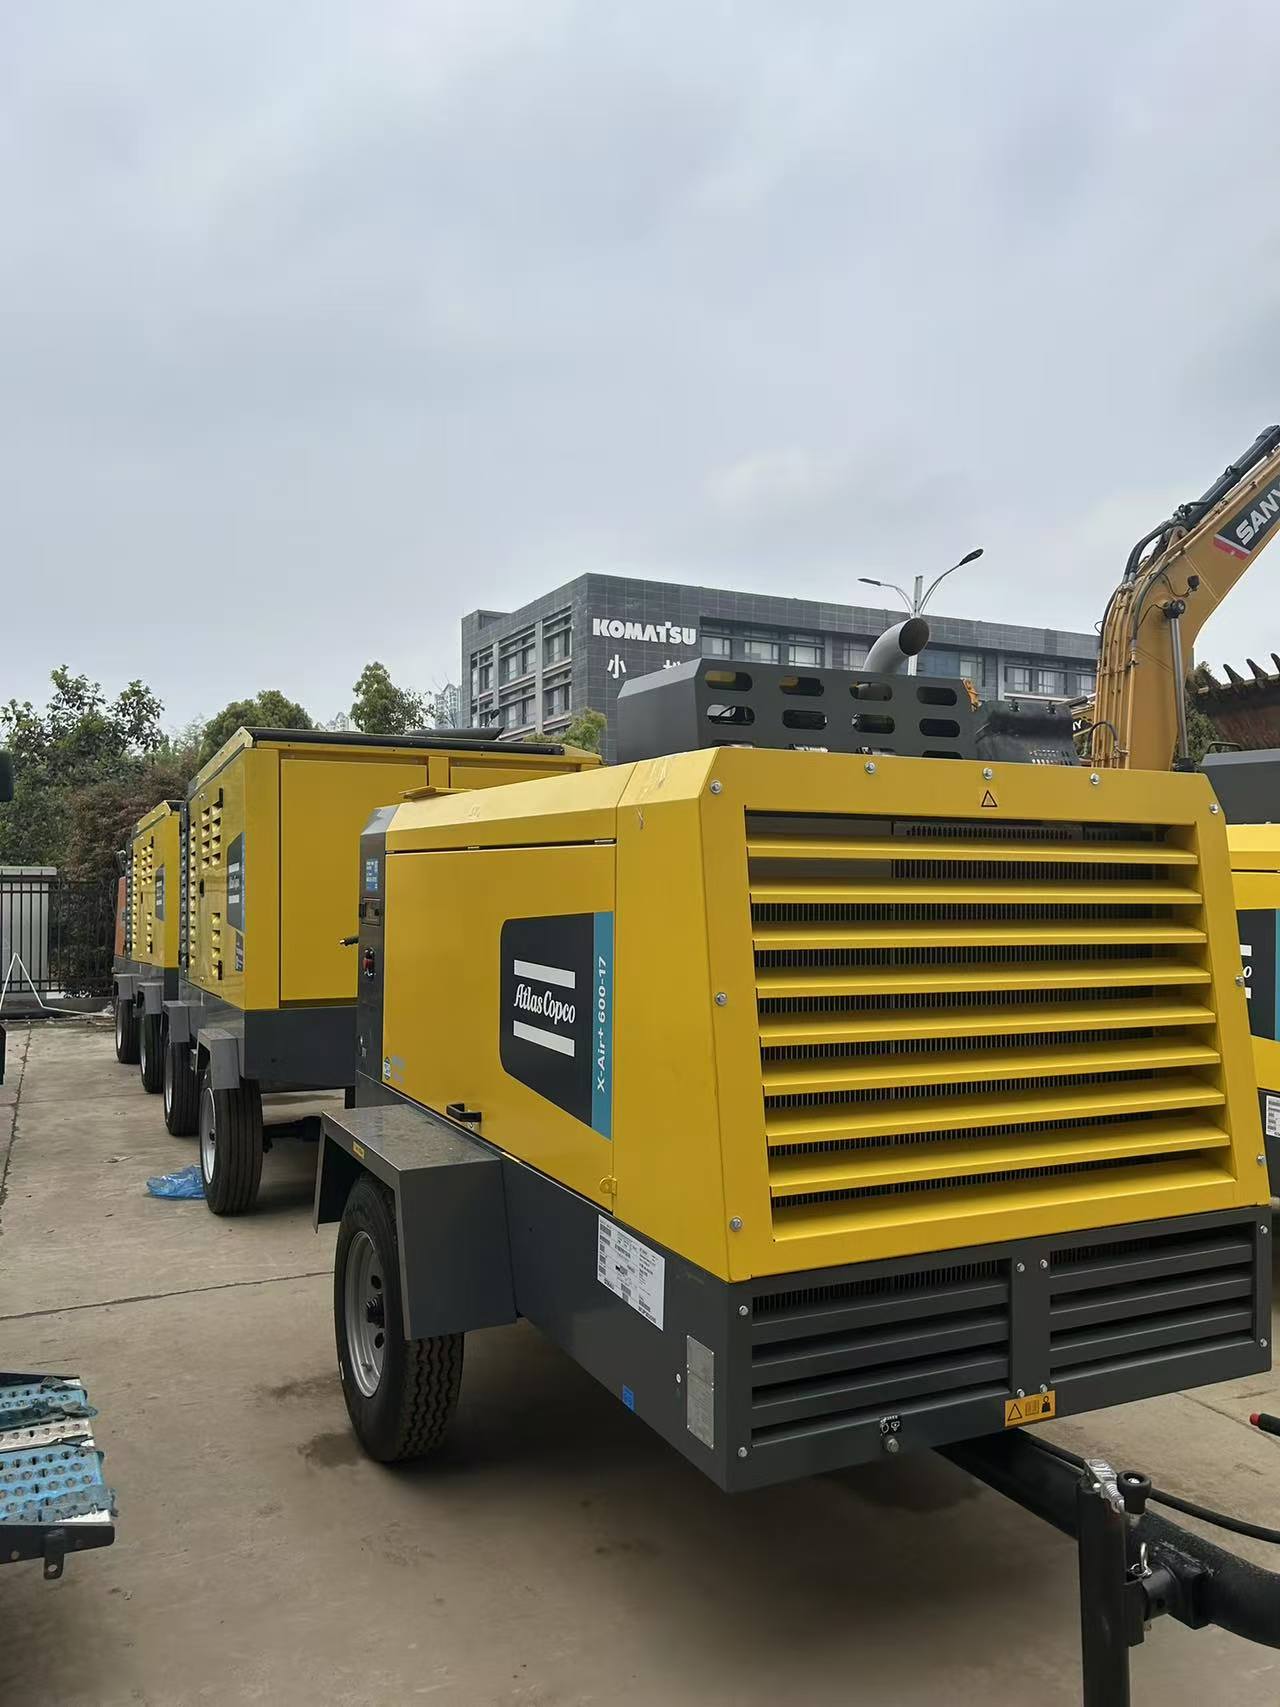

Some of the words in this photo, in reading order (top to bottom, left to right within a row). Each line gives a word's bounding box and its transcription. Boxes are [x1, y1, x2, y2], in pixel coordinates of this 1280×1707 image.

[592, 618, 697, 645] KOMATSU
[597, 956, 606, 1023] 600-17
[597, 1028, 606, 1093] X-Air+
